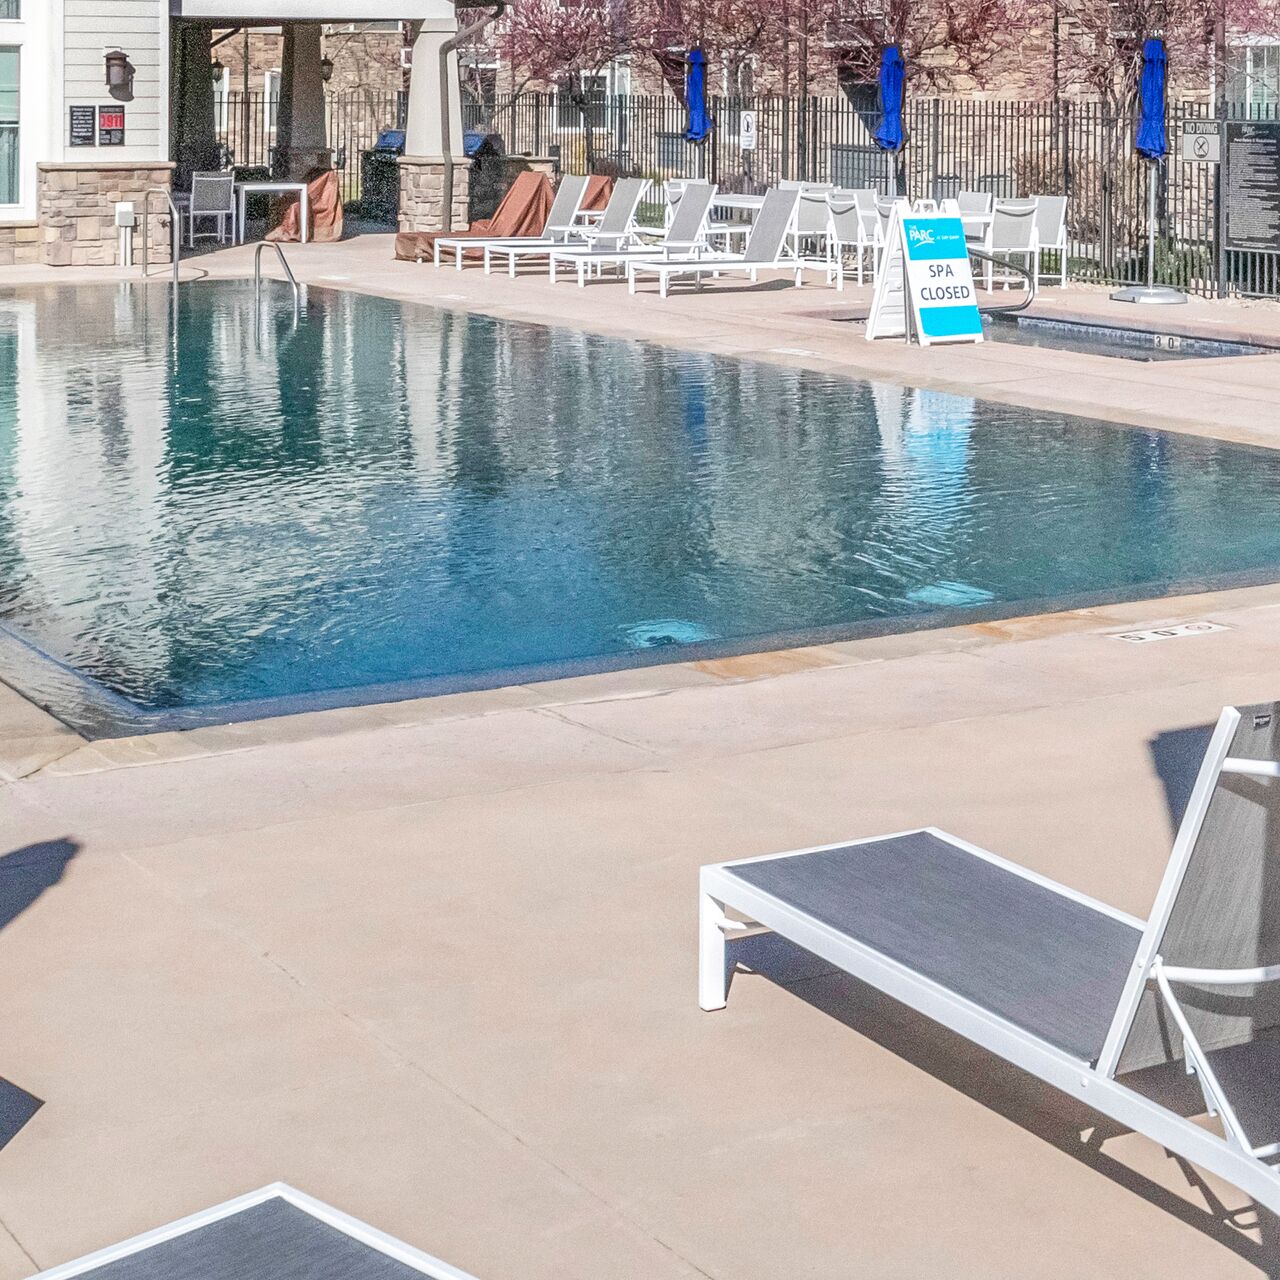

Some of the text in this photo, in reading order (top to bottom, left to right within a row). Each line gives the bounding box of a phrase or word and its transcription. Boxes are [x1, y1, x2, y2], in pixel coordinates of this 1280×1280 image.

[1185, 123, 1218, 133] NO DIVING
[909, 229, 935, 241] PARC
[929, 264, 954, 278] SPA
[920, 286, 970, 301] CLOSED
